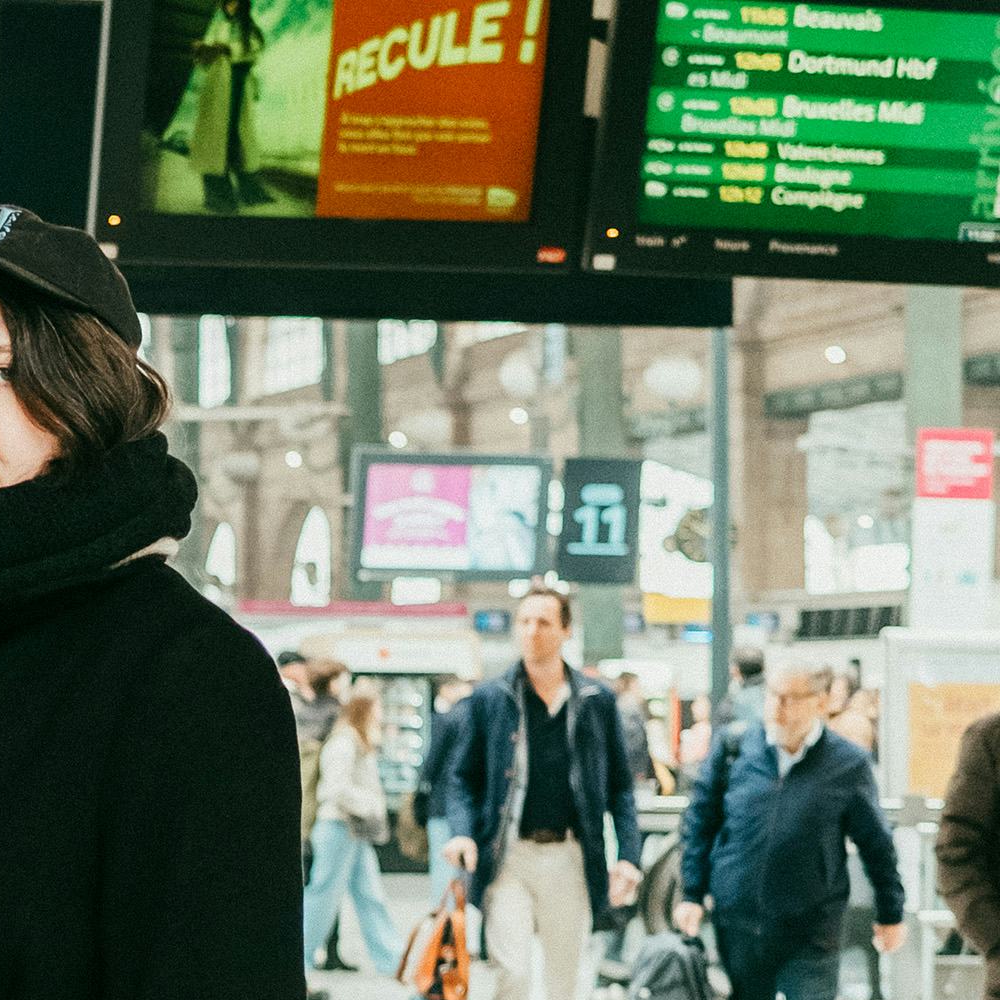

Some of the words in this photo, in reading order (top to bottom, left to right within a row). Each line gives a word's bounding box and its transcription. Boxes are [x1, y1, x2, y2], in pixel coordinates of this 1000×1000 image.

[333, 0, 511, 100] RECULE
[518, 0, 544, 64] !
[787, 49, 895, 78] Dortmund
[573, 503, 628, 547] 11
